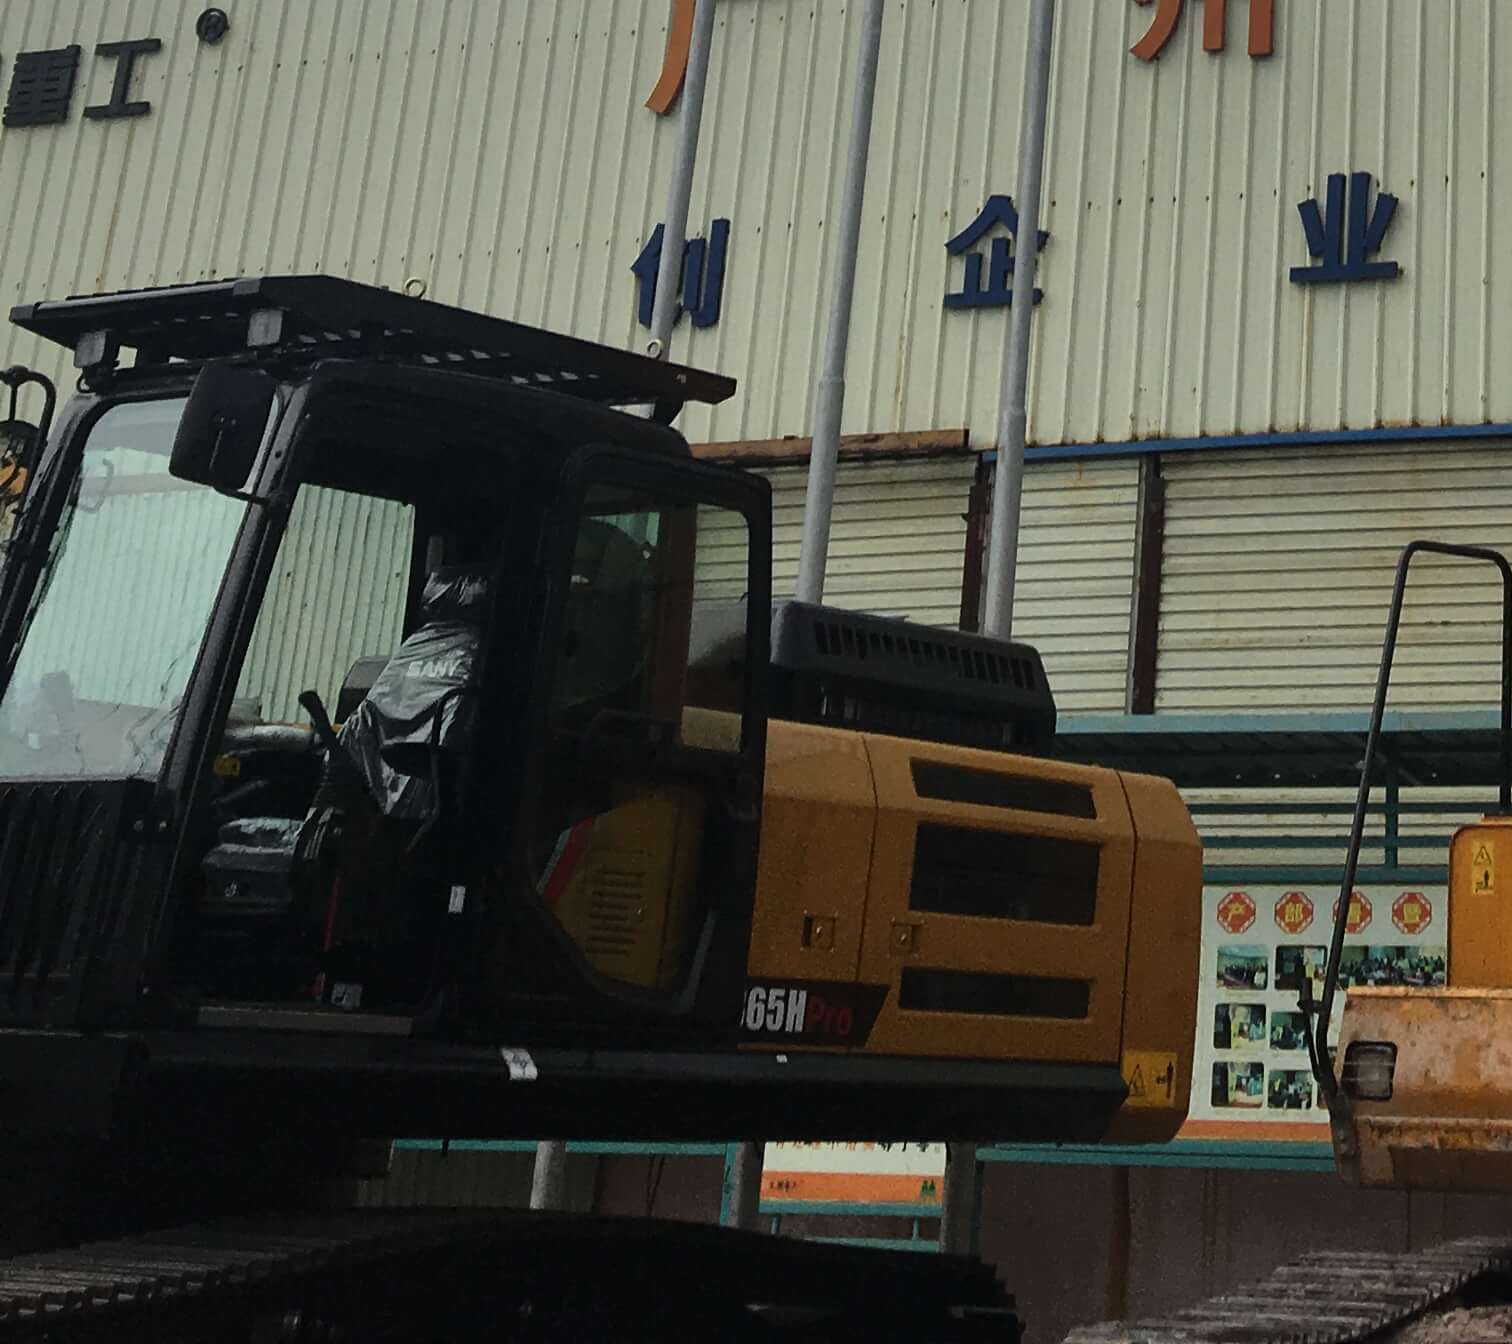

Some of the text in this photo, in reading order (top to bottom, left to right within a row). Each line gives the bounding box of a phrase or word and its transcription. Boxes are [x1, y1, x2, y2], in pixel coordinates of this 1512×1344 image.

[943, 194, 1049, 310] 企
[1289, 172, 1399, 283] 业
[741, 987, 807, 1032] 65H
